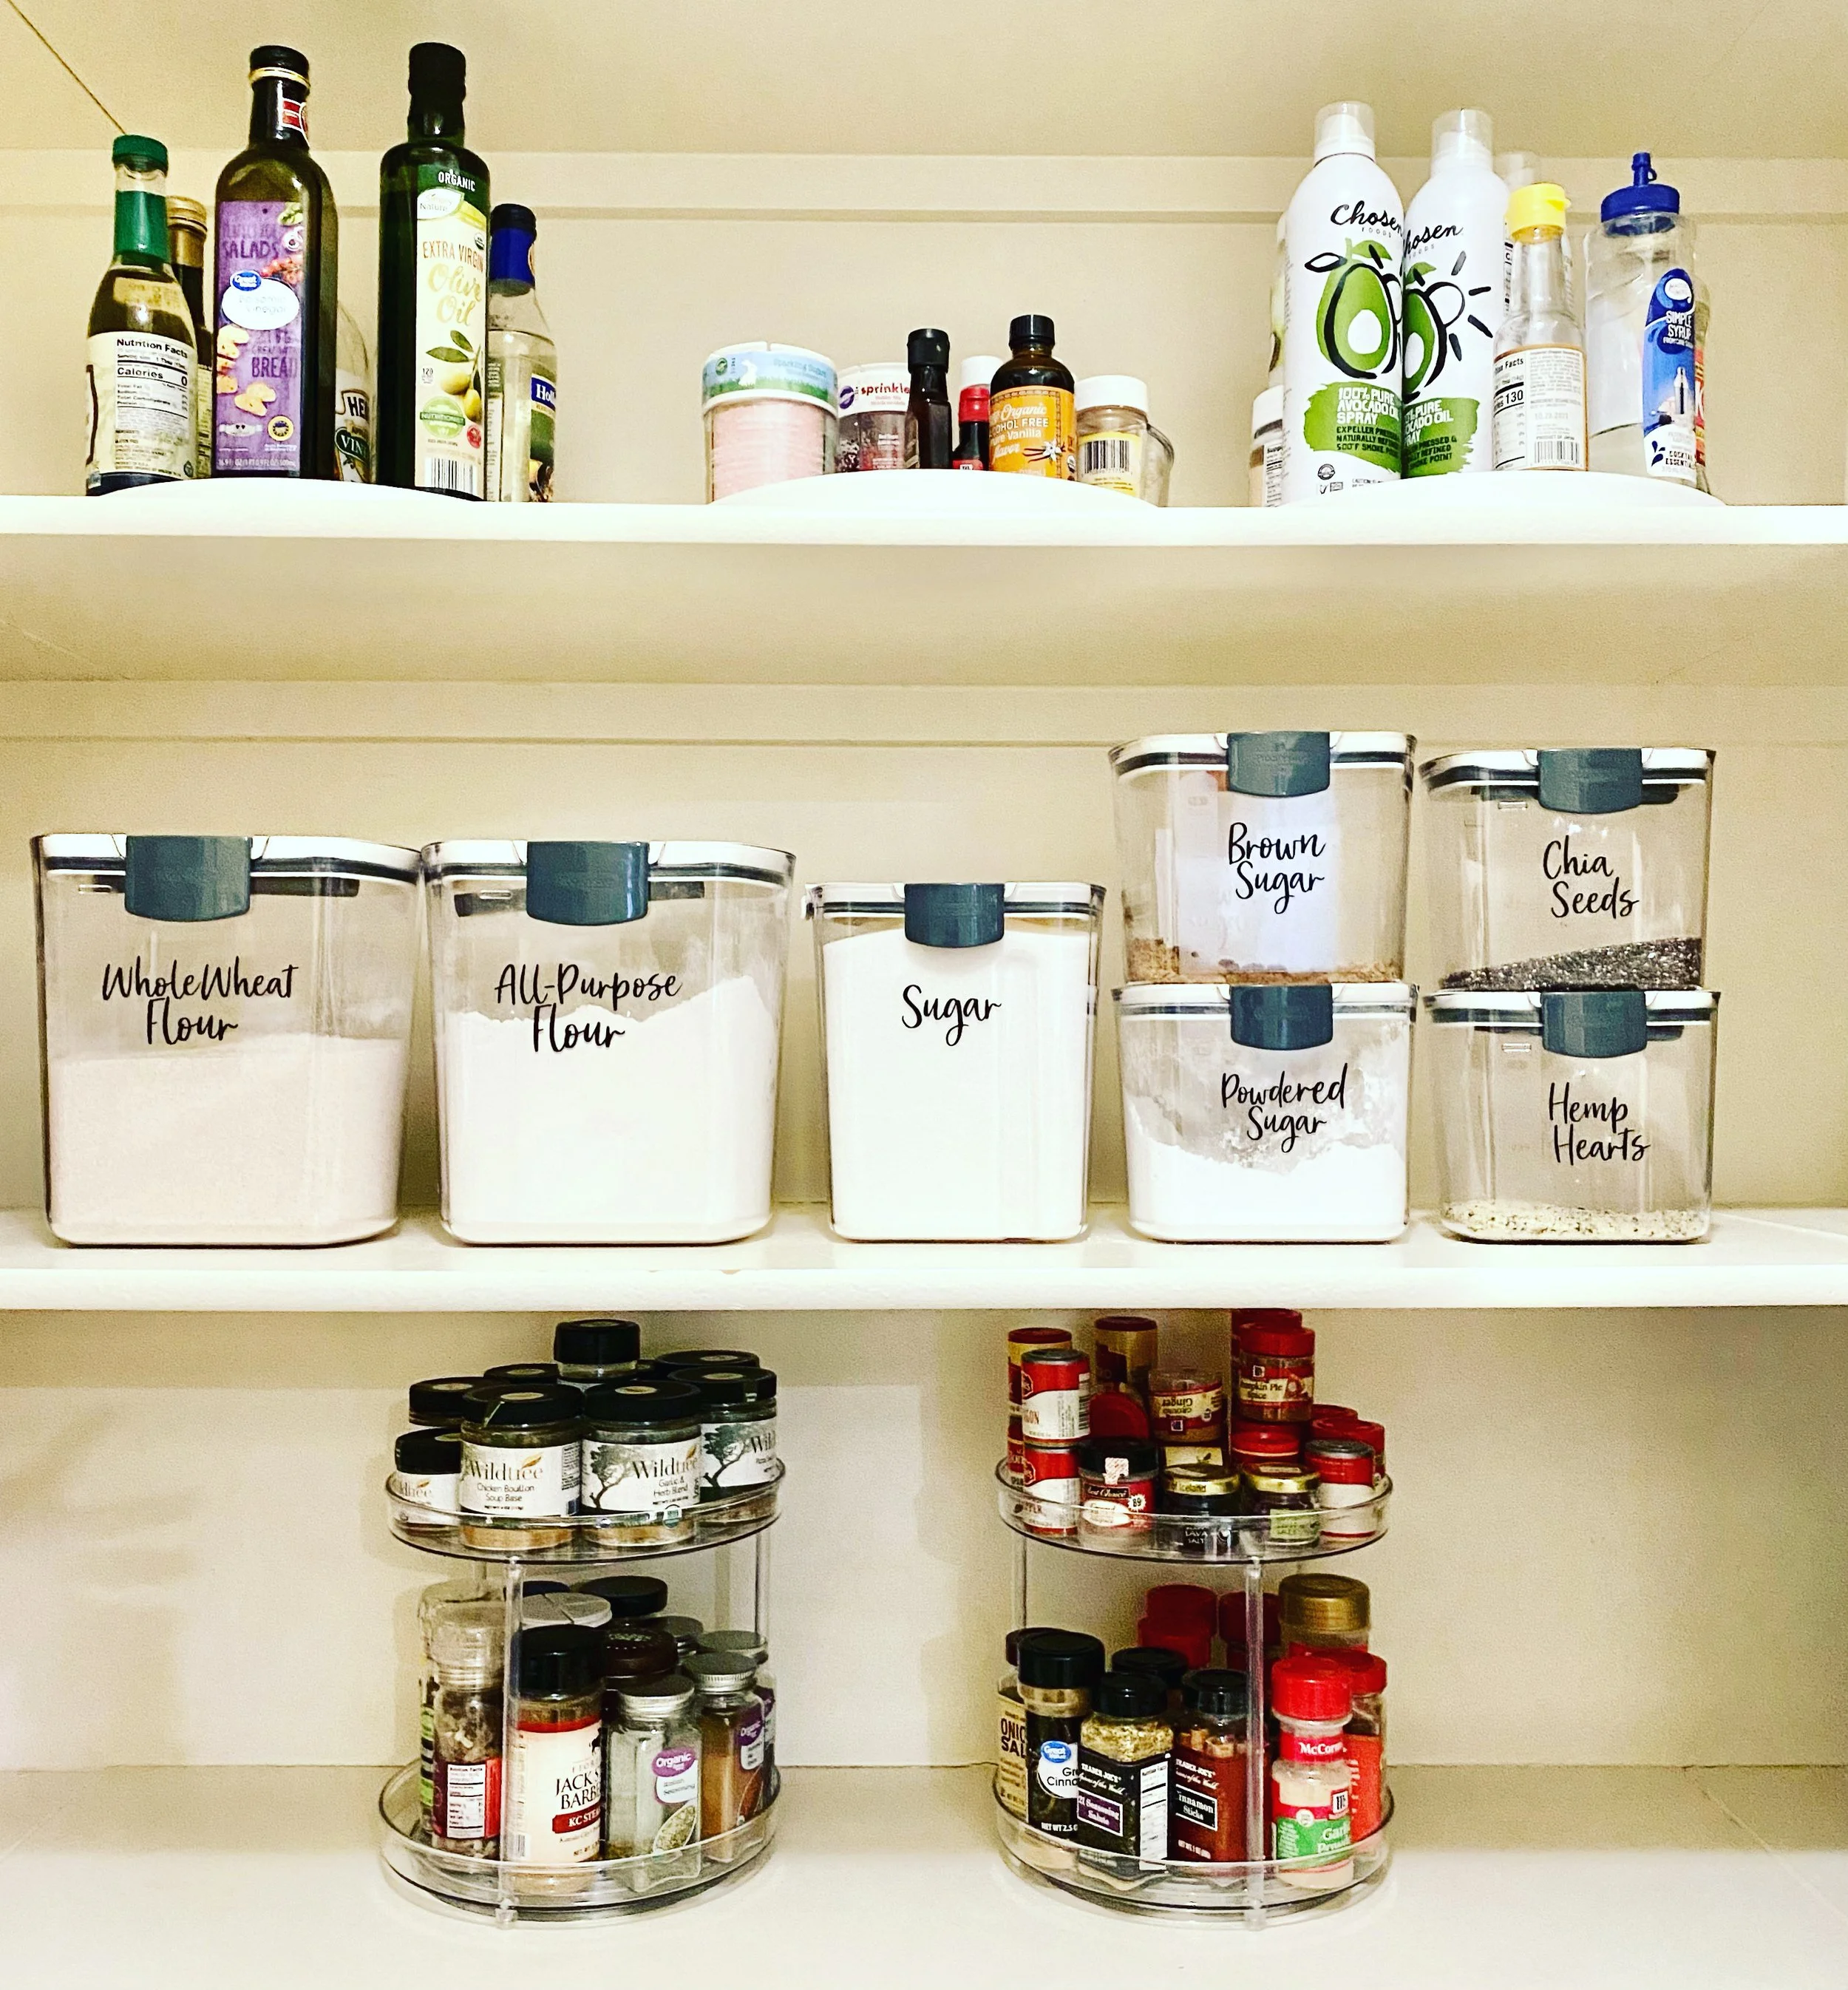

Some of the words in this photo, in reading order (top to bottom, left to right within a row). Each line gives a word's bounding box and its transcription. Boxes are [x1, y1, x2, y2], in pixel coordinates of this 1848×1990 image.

[438, 171, 475, 191] ORGANIC
[1331, 200, 1403, 237] Chosen
[222, 240, 279, 259] SALADS
[1404, 225, 1464, 259] hosen
[422, 240, 455, 259] EXTRA
[458, 244, 484, 273] VIRGIN
[427, 263, 483, 302] Olive
[435, 295, 477, 327] Oil
[1665, 310, 1693, 329] SIMPLE
[1668, 324, 1692, 341] SYRUP
[117, 339, 163, 351] Nutrition
[165, 344, 188, 359] Facts
[1505, 358, 1524, 369] Facts
[117, 367, 163, 379] Calories
[181, 376, 188, 387] 0
[535, 383, 555, 405] Holl
[860, 382, 911, 396] sprinkle
[1338, 387, 1370, 400] 100%
[1370, 389, 1395, 406] PURE
[1506, 390, 1523, 404] 130
[1000, 404, 1047, 421] Organic
[1336, 399, 1389, 416] AVOCADO
[1415, 399, 1443, 417] PURE
[1433, 409, 1454, 424] OIL
[1022, 417, 1050, 428] FREE
[1336, 411, 1379, 426] SPRAY
[341, 434, 366, 456] VIN
[1007, 428, 1042, 441] Vanilla
[1336, 434, 1376, 444] NATURALLY
[1229, 822, 1326, 865] Brown
[1543, 835, 1614, 880] Chia
[1235, 860, 1325, 914] Sugar
[1551, 877, 1640, 919] Seeds
[102, 955, 299, 1001] WholeWheat
[495, 963, 683, 1011] All-Purpose
[147, 996, 238, 1045] Flour
[902, 985, 1002, 1047] Sugar
[533, 1003, 625, 1053] Flour
[1221, 1062, 1348, 1109] Powdered
[1549, 1081, 1628, 1134] Hemp
[1246, 1105, 1327, 1152] Sugar
[1554, 1124, 1651, 1166] Hearts
[1161, 1396, 1193, 1408] Ginger
[469, 1459, 544, 1481] Wildtree
[632, 1456, 699, 1479] Wildtree
[1185, 1529, 1209, 1538] LAVA
[1187, 1538, 1206, 1546] SALT
[1002, 1736, 1027, 1759] SAL
[656, 1752, 693, 1768] Organic
[1047, 1776, 1078, 1787] Cinna
[1062, 1767, 1078, 1777] Gr
[556, 1772, 593, 1796] JACK
[561, 1784, 597, 1810] BARB
[568, 1815, 583, 1827] KC
